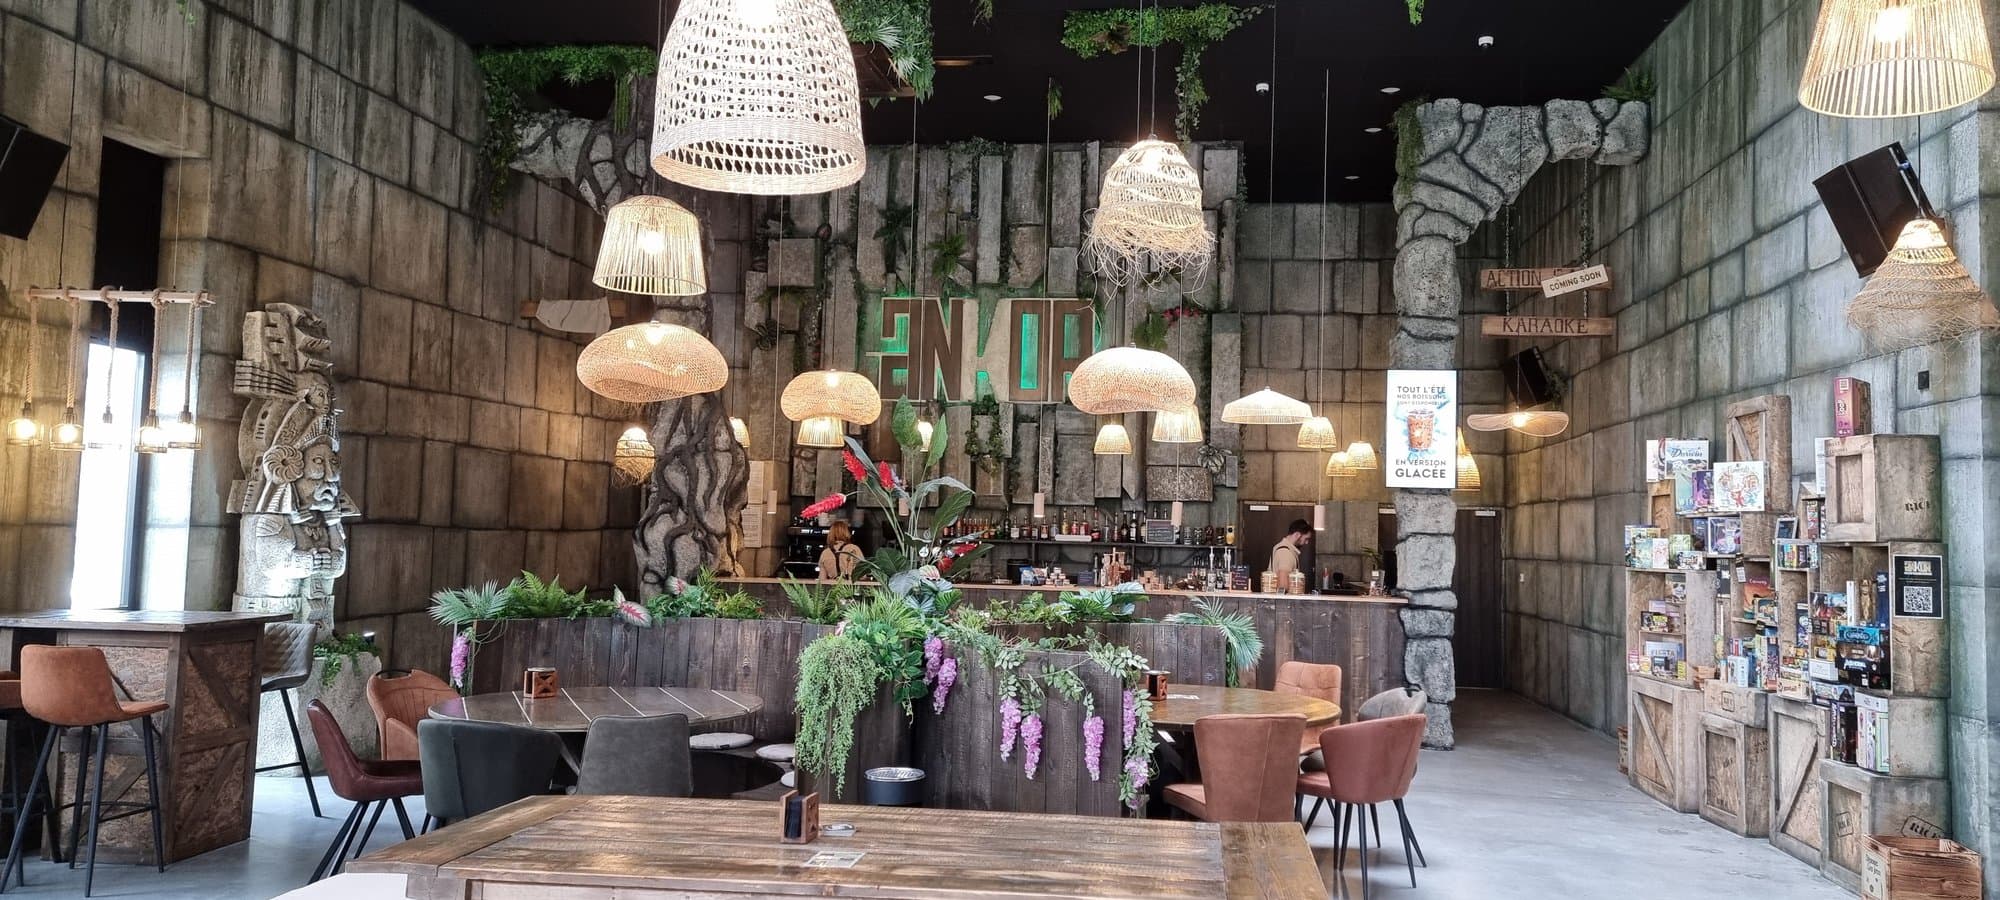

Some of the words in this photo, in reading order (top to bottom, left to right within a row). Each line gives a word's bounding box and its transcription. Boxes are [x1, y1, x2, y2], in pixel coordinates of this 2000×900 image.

[1486, 269, 1542, 287] ACTION
[1549, 277, 1579, 291] COMING
[1580, 270, 1602, 283] SOON
[1502, 317, 1588, 334] KARAOKE
[1396, 385, 1421, 393] TOUT
[1409, 459, 1447, 467] VERSION
[1395, 466, 1447, 479] GLACÉE
